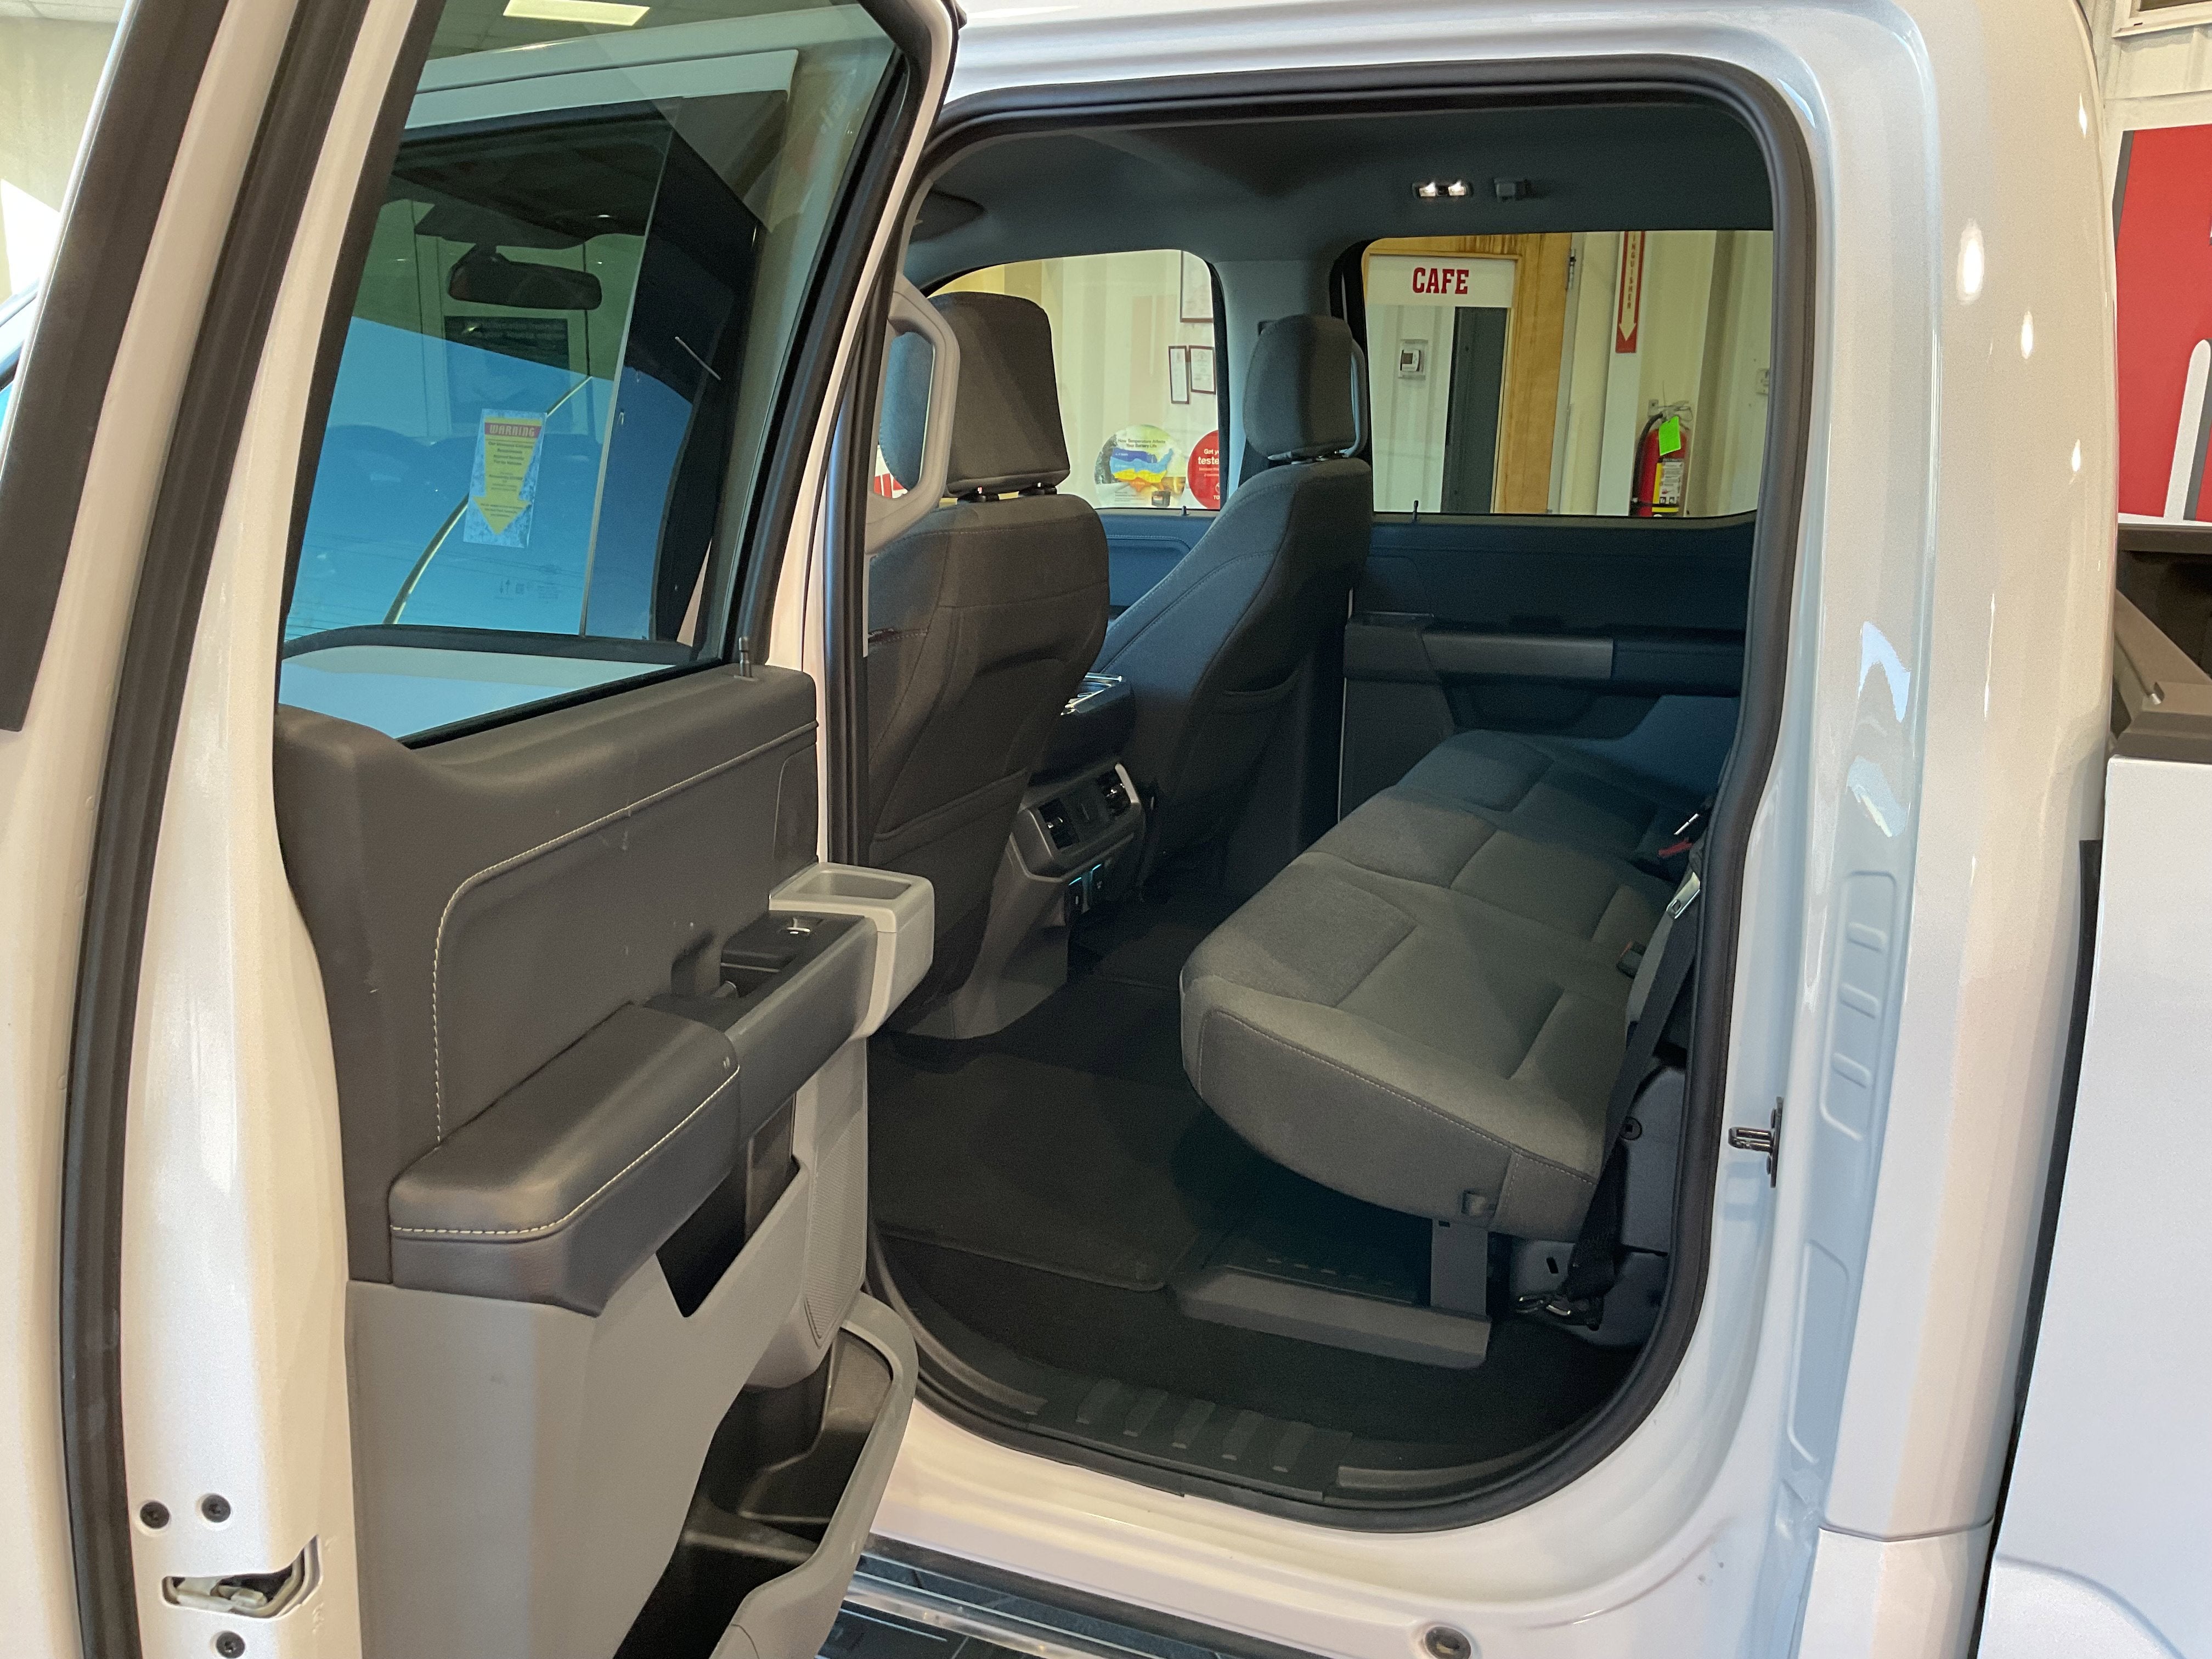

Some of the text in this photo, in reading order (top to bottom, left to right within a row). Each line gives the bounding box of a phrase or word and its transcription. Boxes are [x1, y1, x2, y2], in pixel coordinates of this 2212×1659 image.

[1413, 267, 1469, 294] CAFE
[489, 424, 535, 437] WARNING
[1198, 456, 1219, 465] teste
